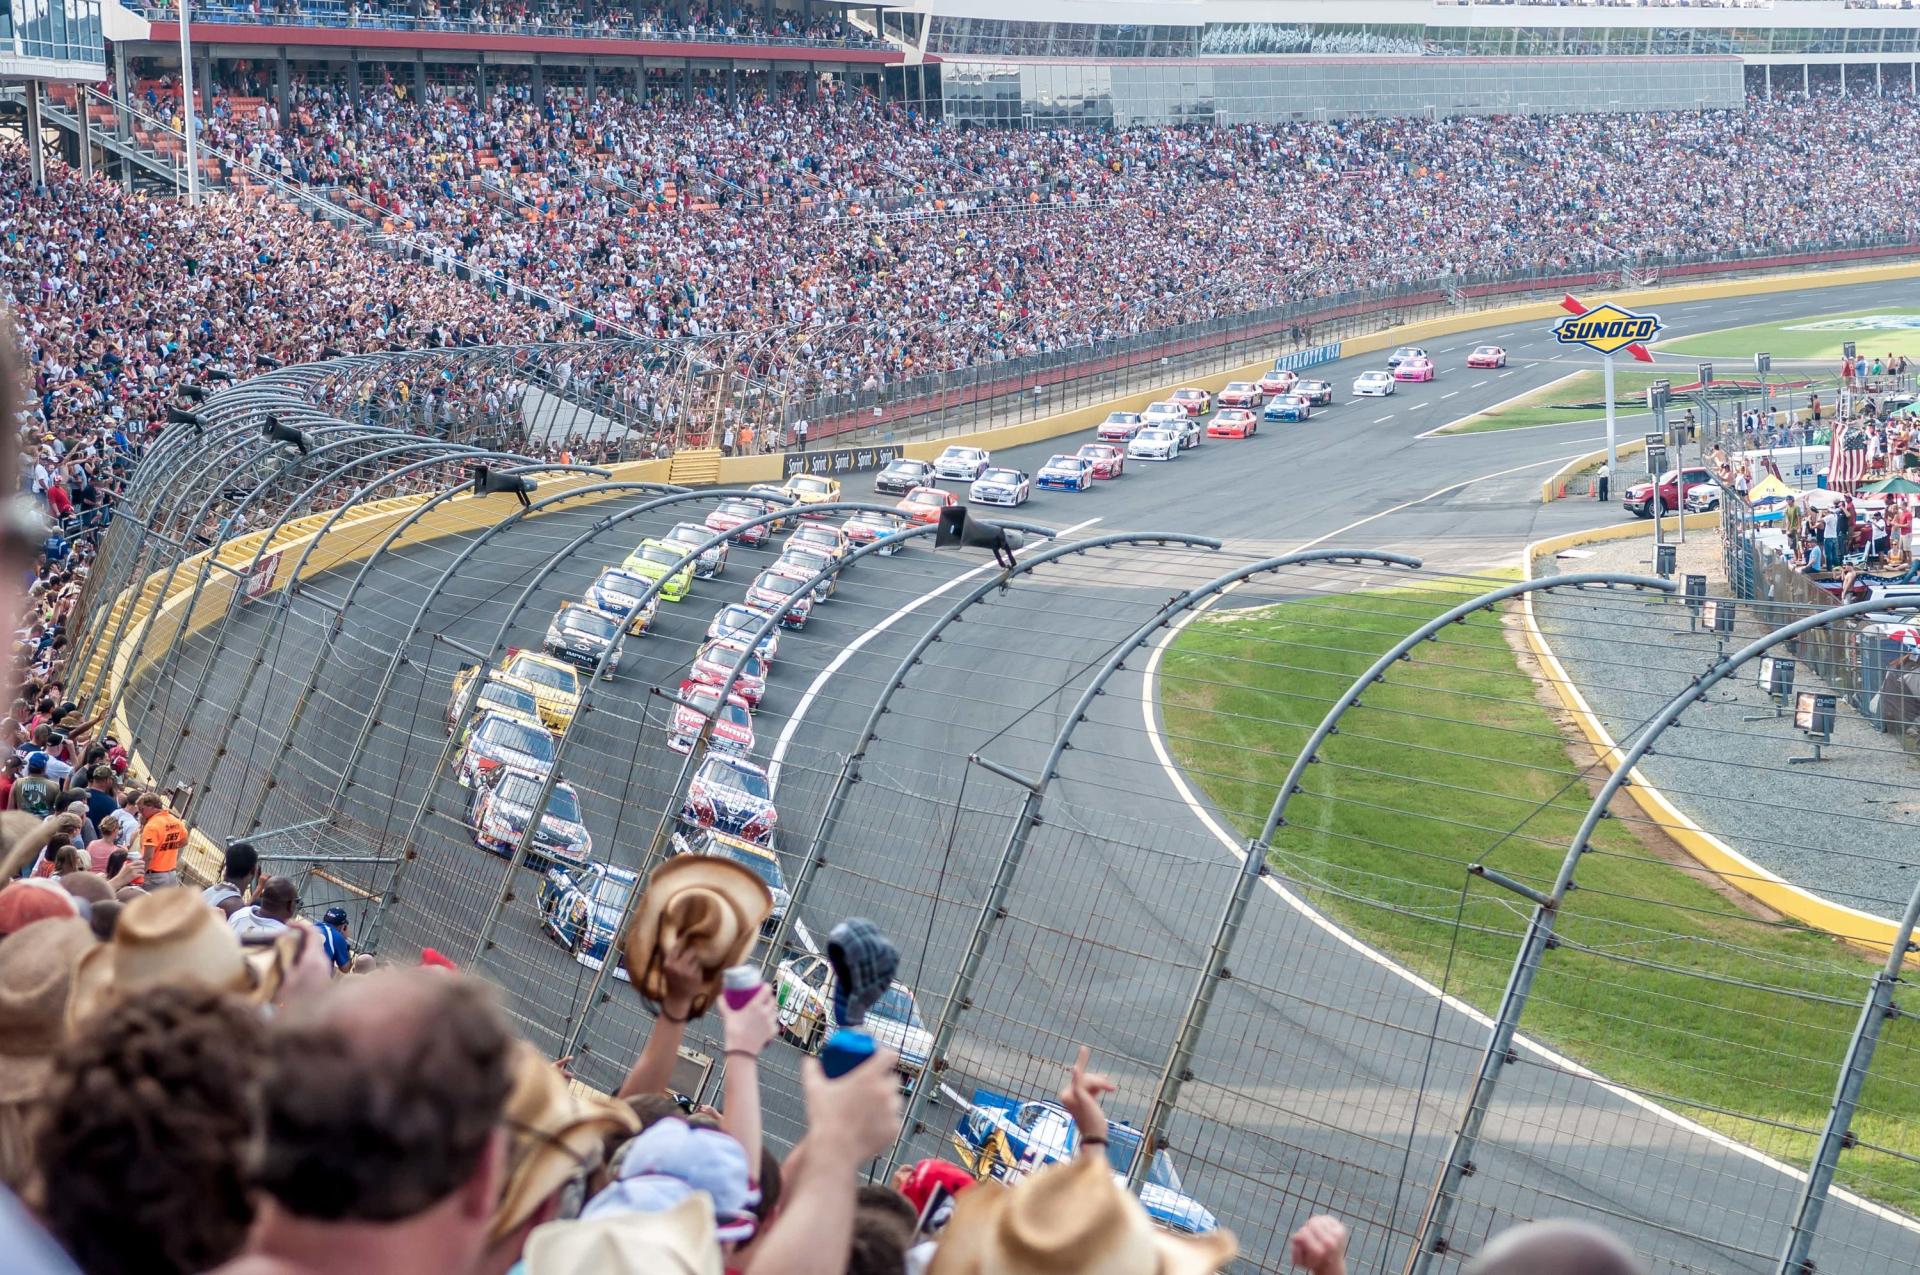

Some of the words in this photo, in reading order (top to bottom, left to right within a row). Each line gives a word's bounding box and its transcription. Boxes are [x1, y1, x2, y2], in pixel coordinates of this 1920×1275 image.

[1562, 320, 1652, 339] SUNOCO
[1276, 347, 1323, 372] CHARLOTTE
[1326, 343, 1340, 359] USA
[788, 457, 804, 477] Sprint
[812, 455, 827, 475] Sprint
[835, 453, 849, 473] Sprint
[857, 450, 872, 471] Sprint
[880, 448, 893, 468] Sprint
[1794, 468, 1813, 476] EMS
[566, 650, 593, 662] IMPALA
